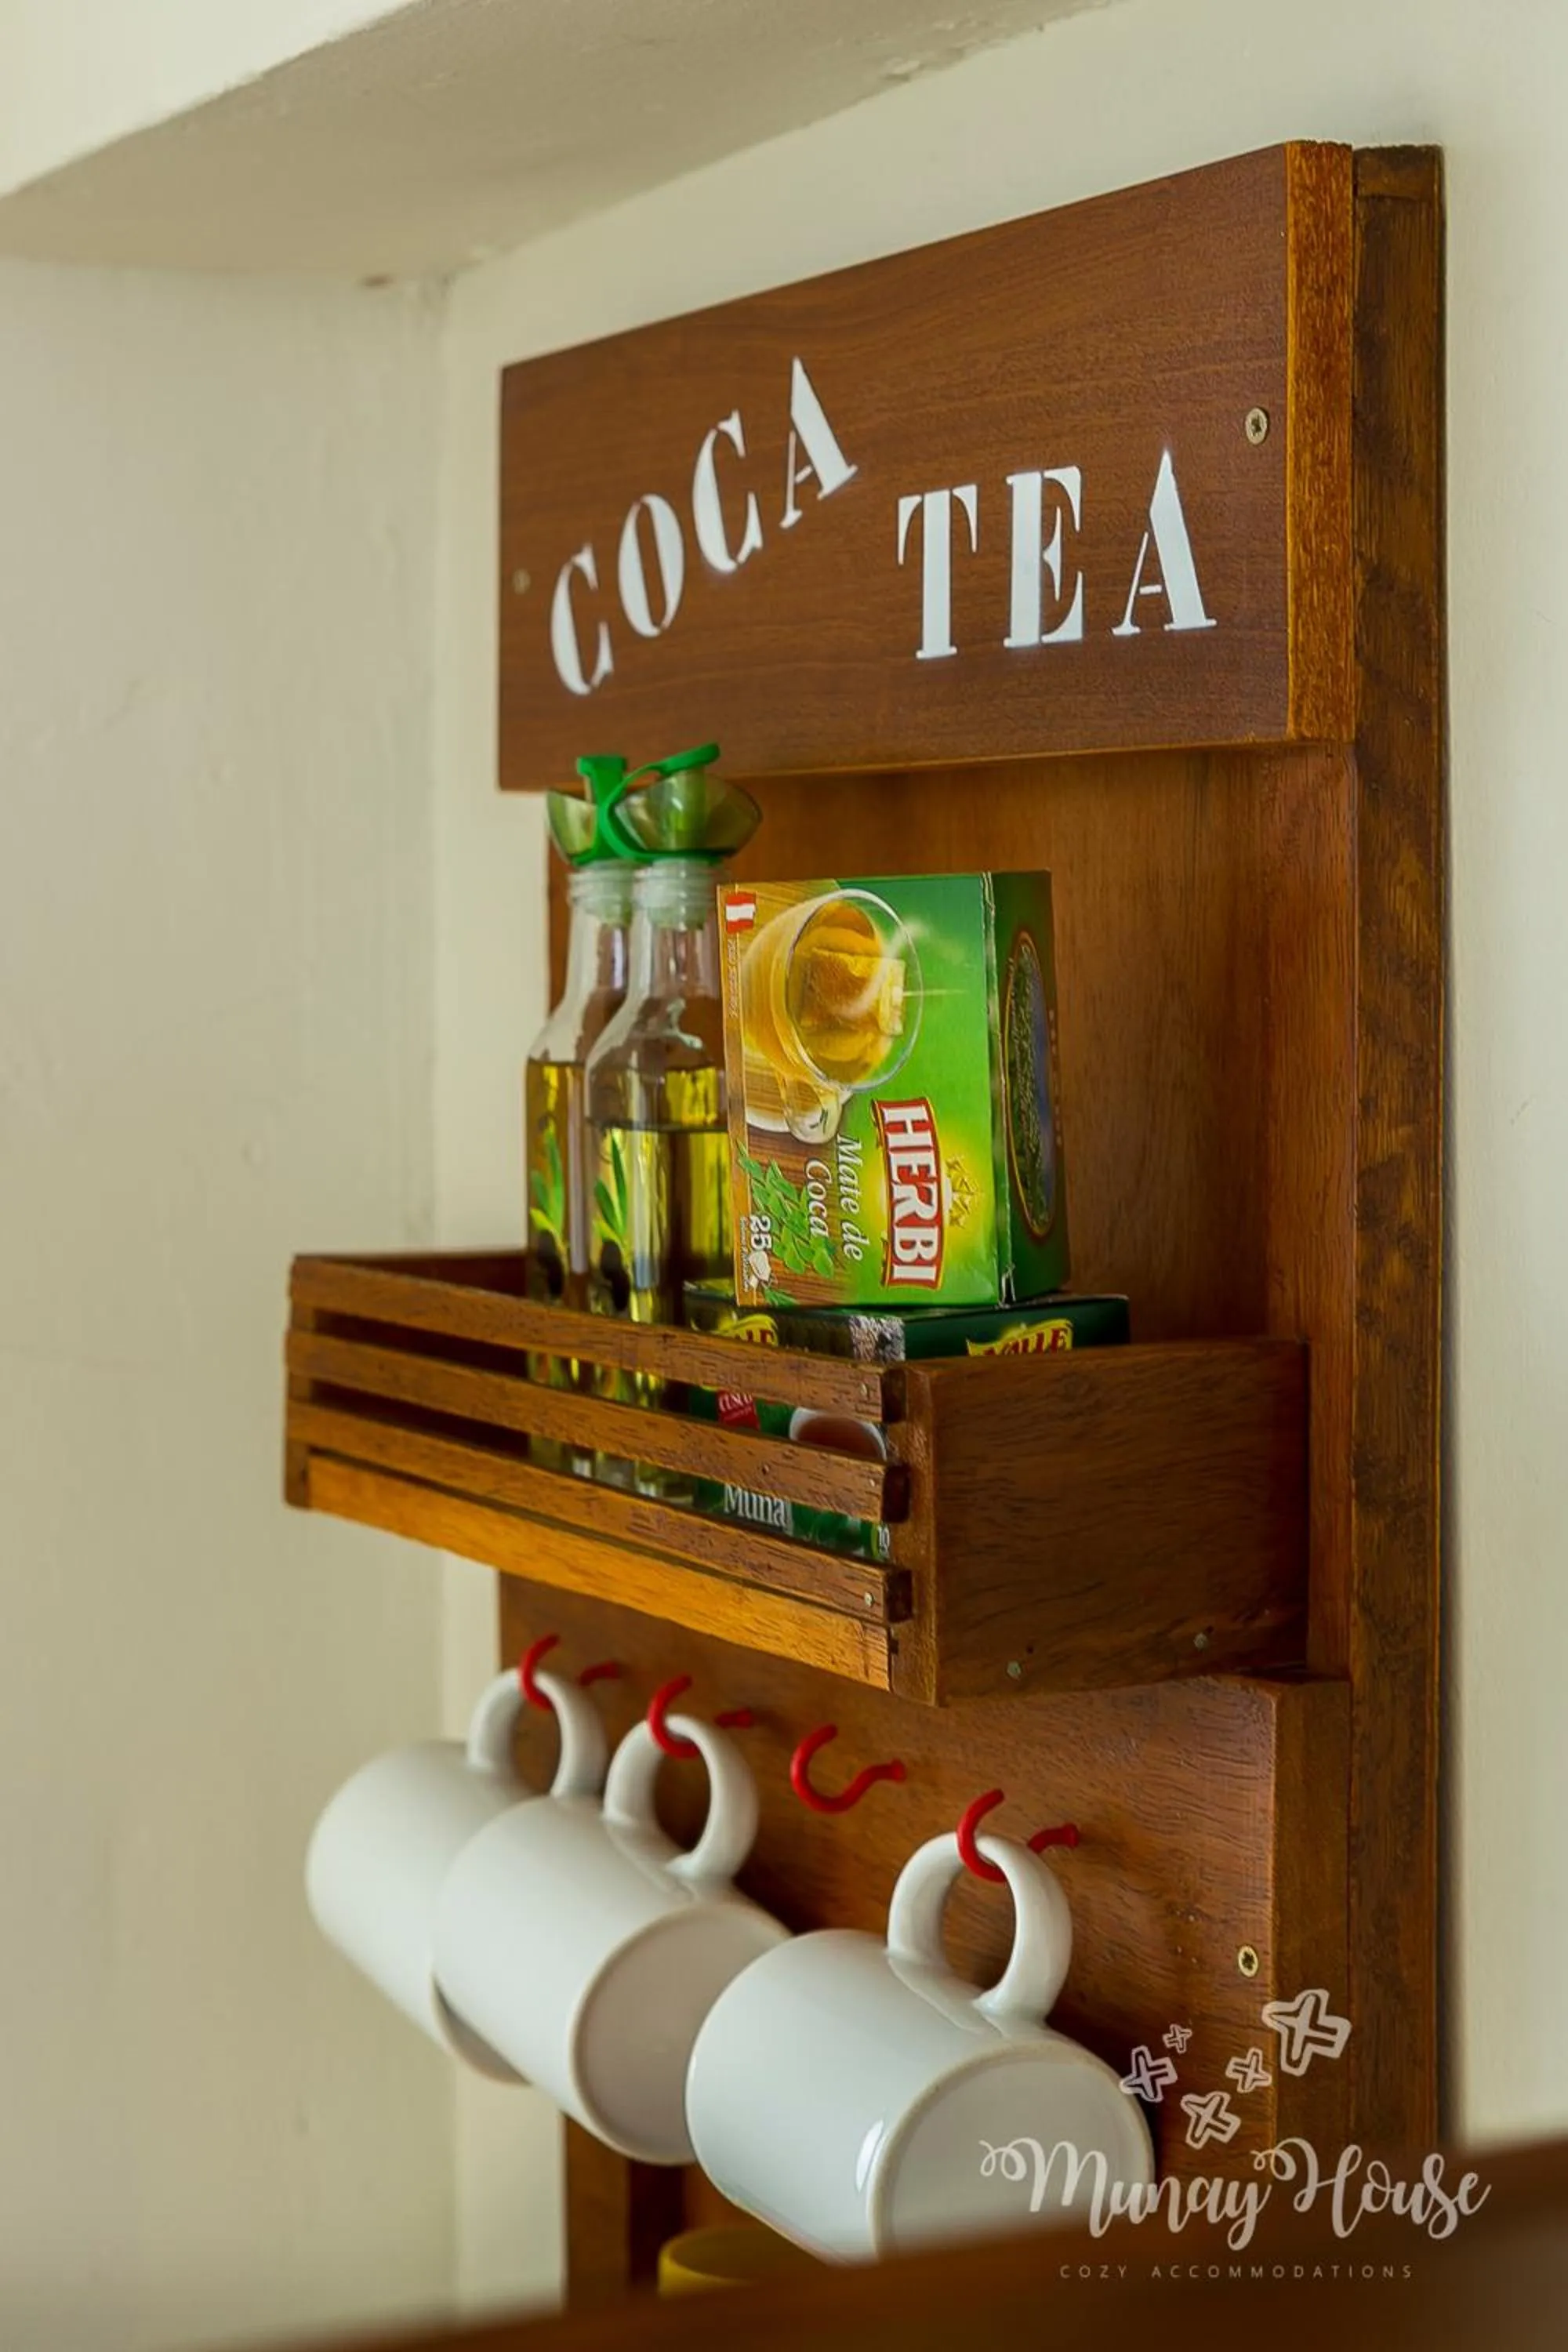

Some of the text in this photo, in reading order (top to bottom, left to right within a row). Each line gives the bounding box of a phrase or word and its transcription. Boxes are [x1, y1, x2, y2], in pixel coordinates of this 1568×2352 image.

[550, 356, 1217, 695] COCA TEA
[750, 1214, 772, 1251] 25
[806, 1159, 833, 1239] Coca
[837, 1134, 870, 1261] Mate de
[882, 1105, 938, 1280] HERBI
